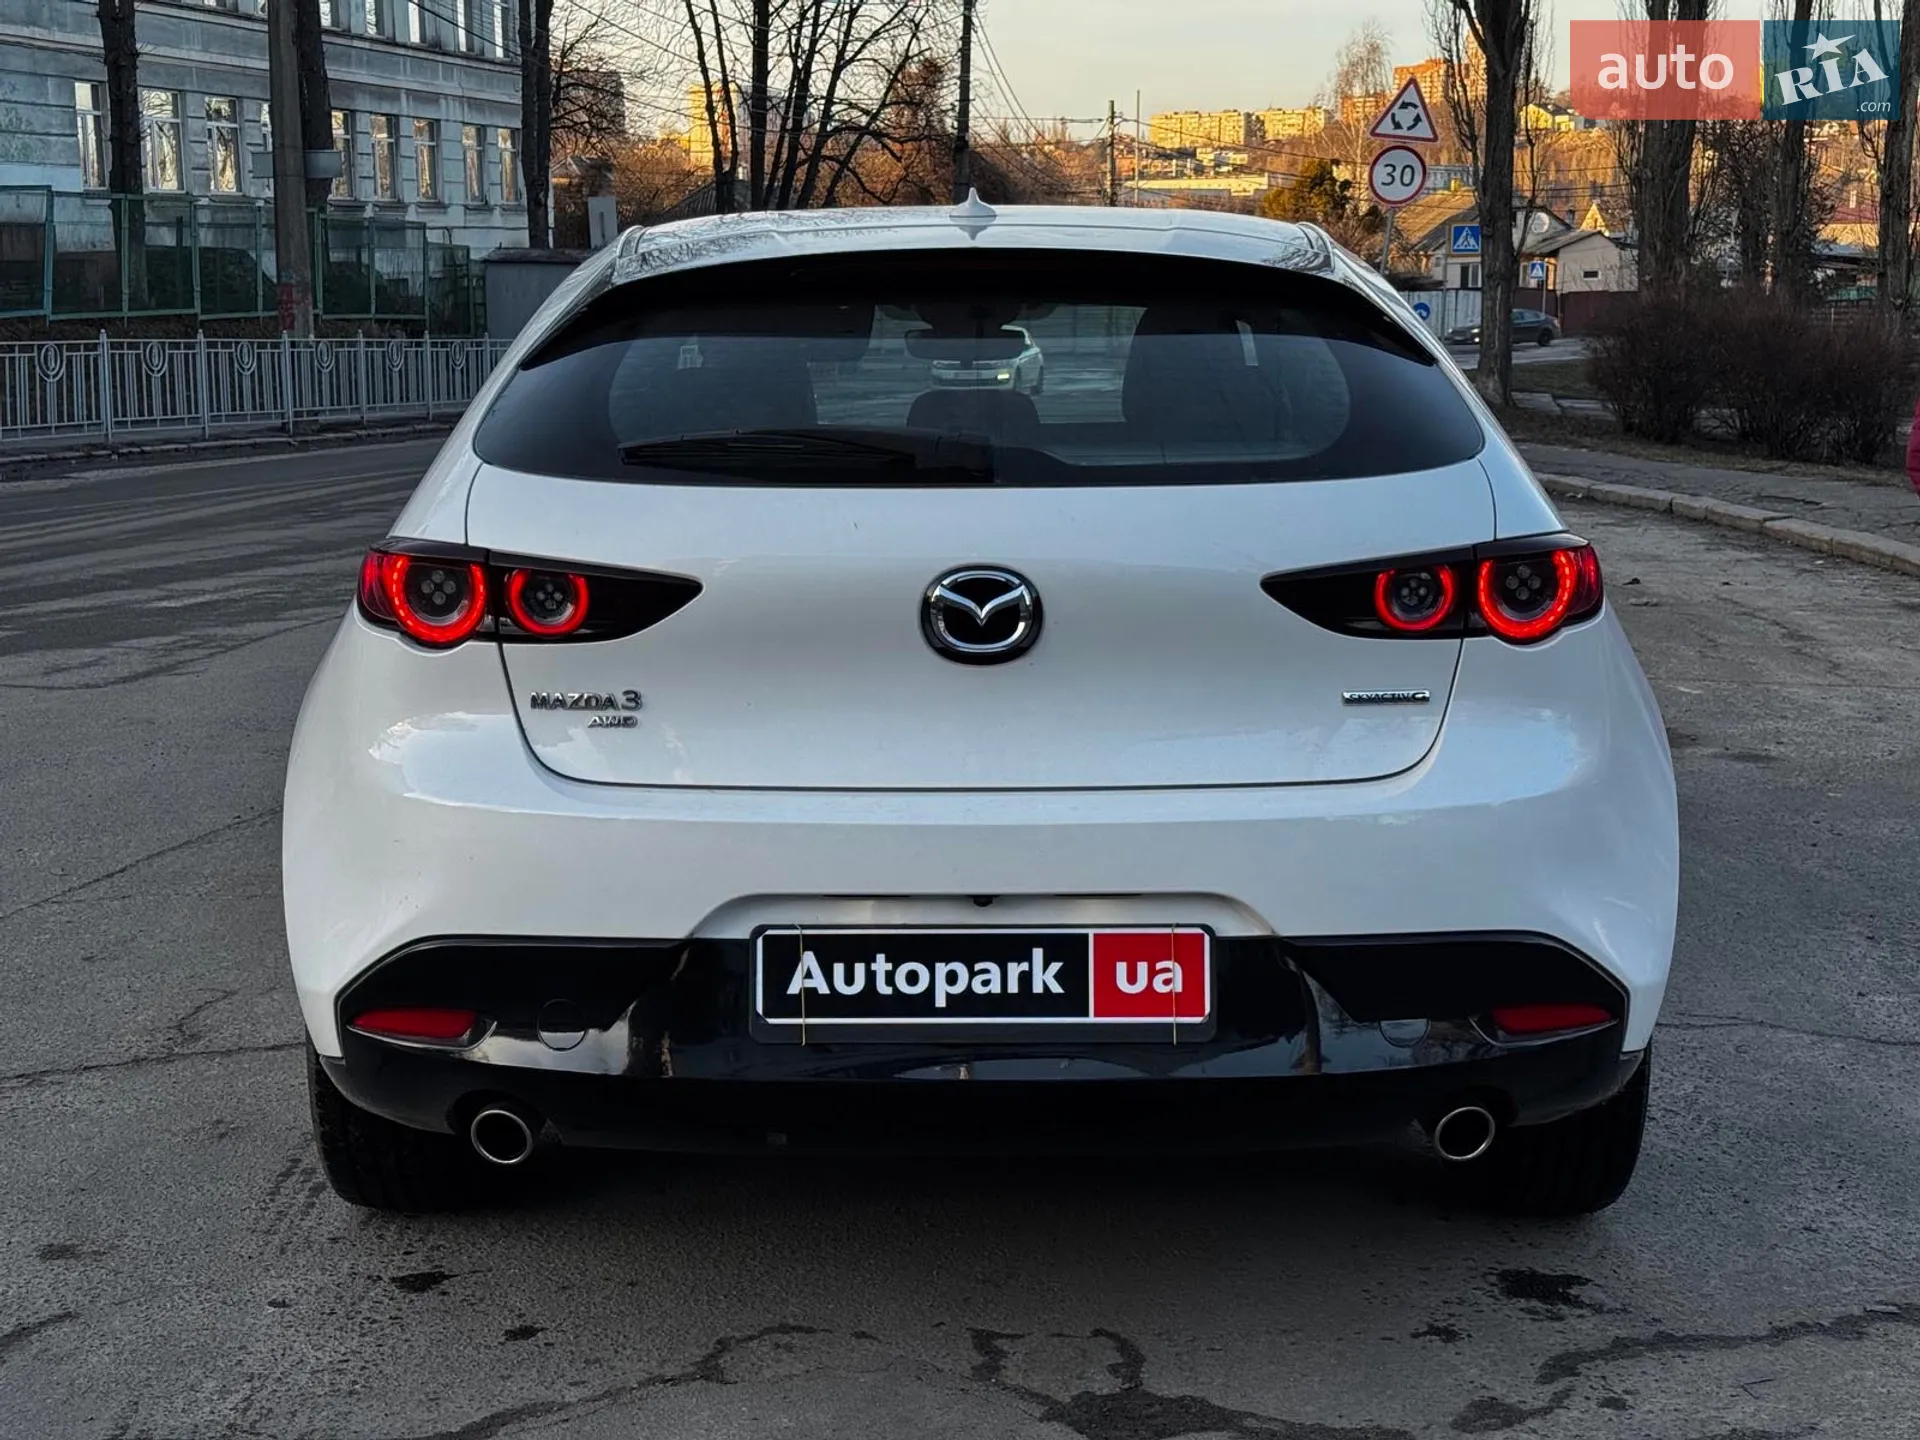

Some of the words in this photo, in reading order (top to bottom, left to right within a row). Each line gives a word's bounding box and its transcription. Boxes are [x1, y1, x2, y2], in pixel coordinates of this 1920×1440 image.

[1381, 163, 1415, 187] 30
[587, 715, 638, 728] AWD
[786, 947, 1065, 1008] Autopark
[1116, 961, 1183, 994] ua
